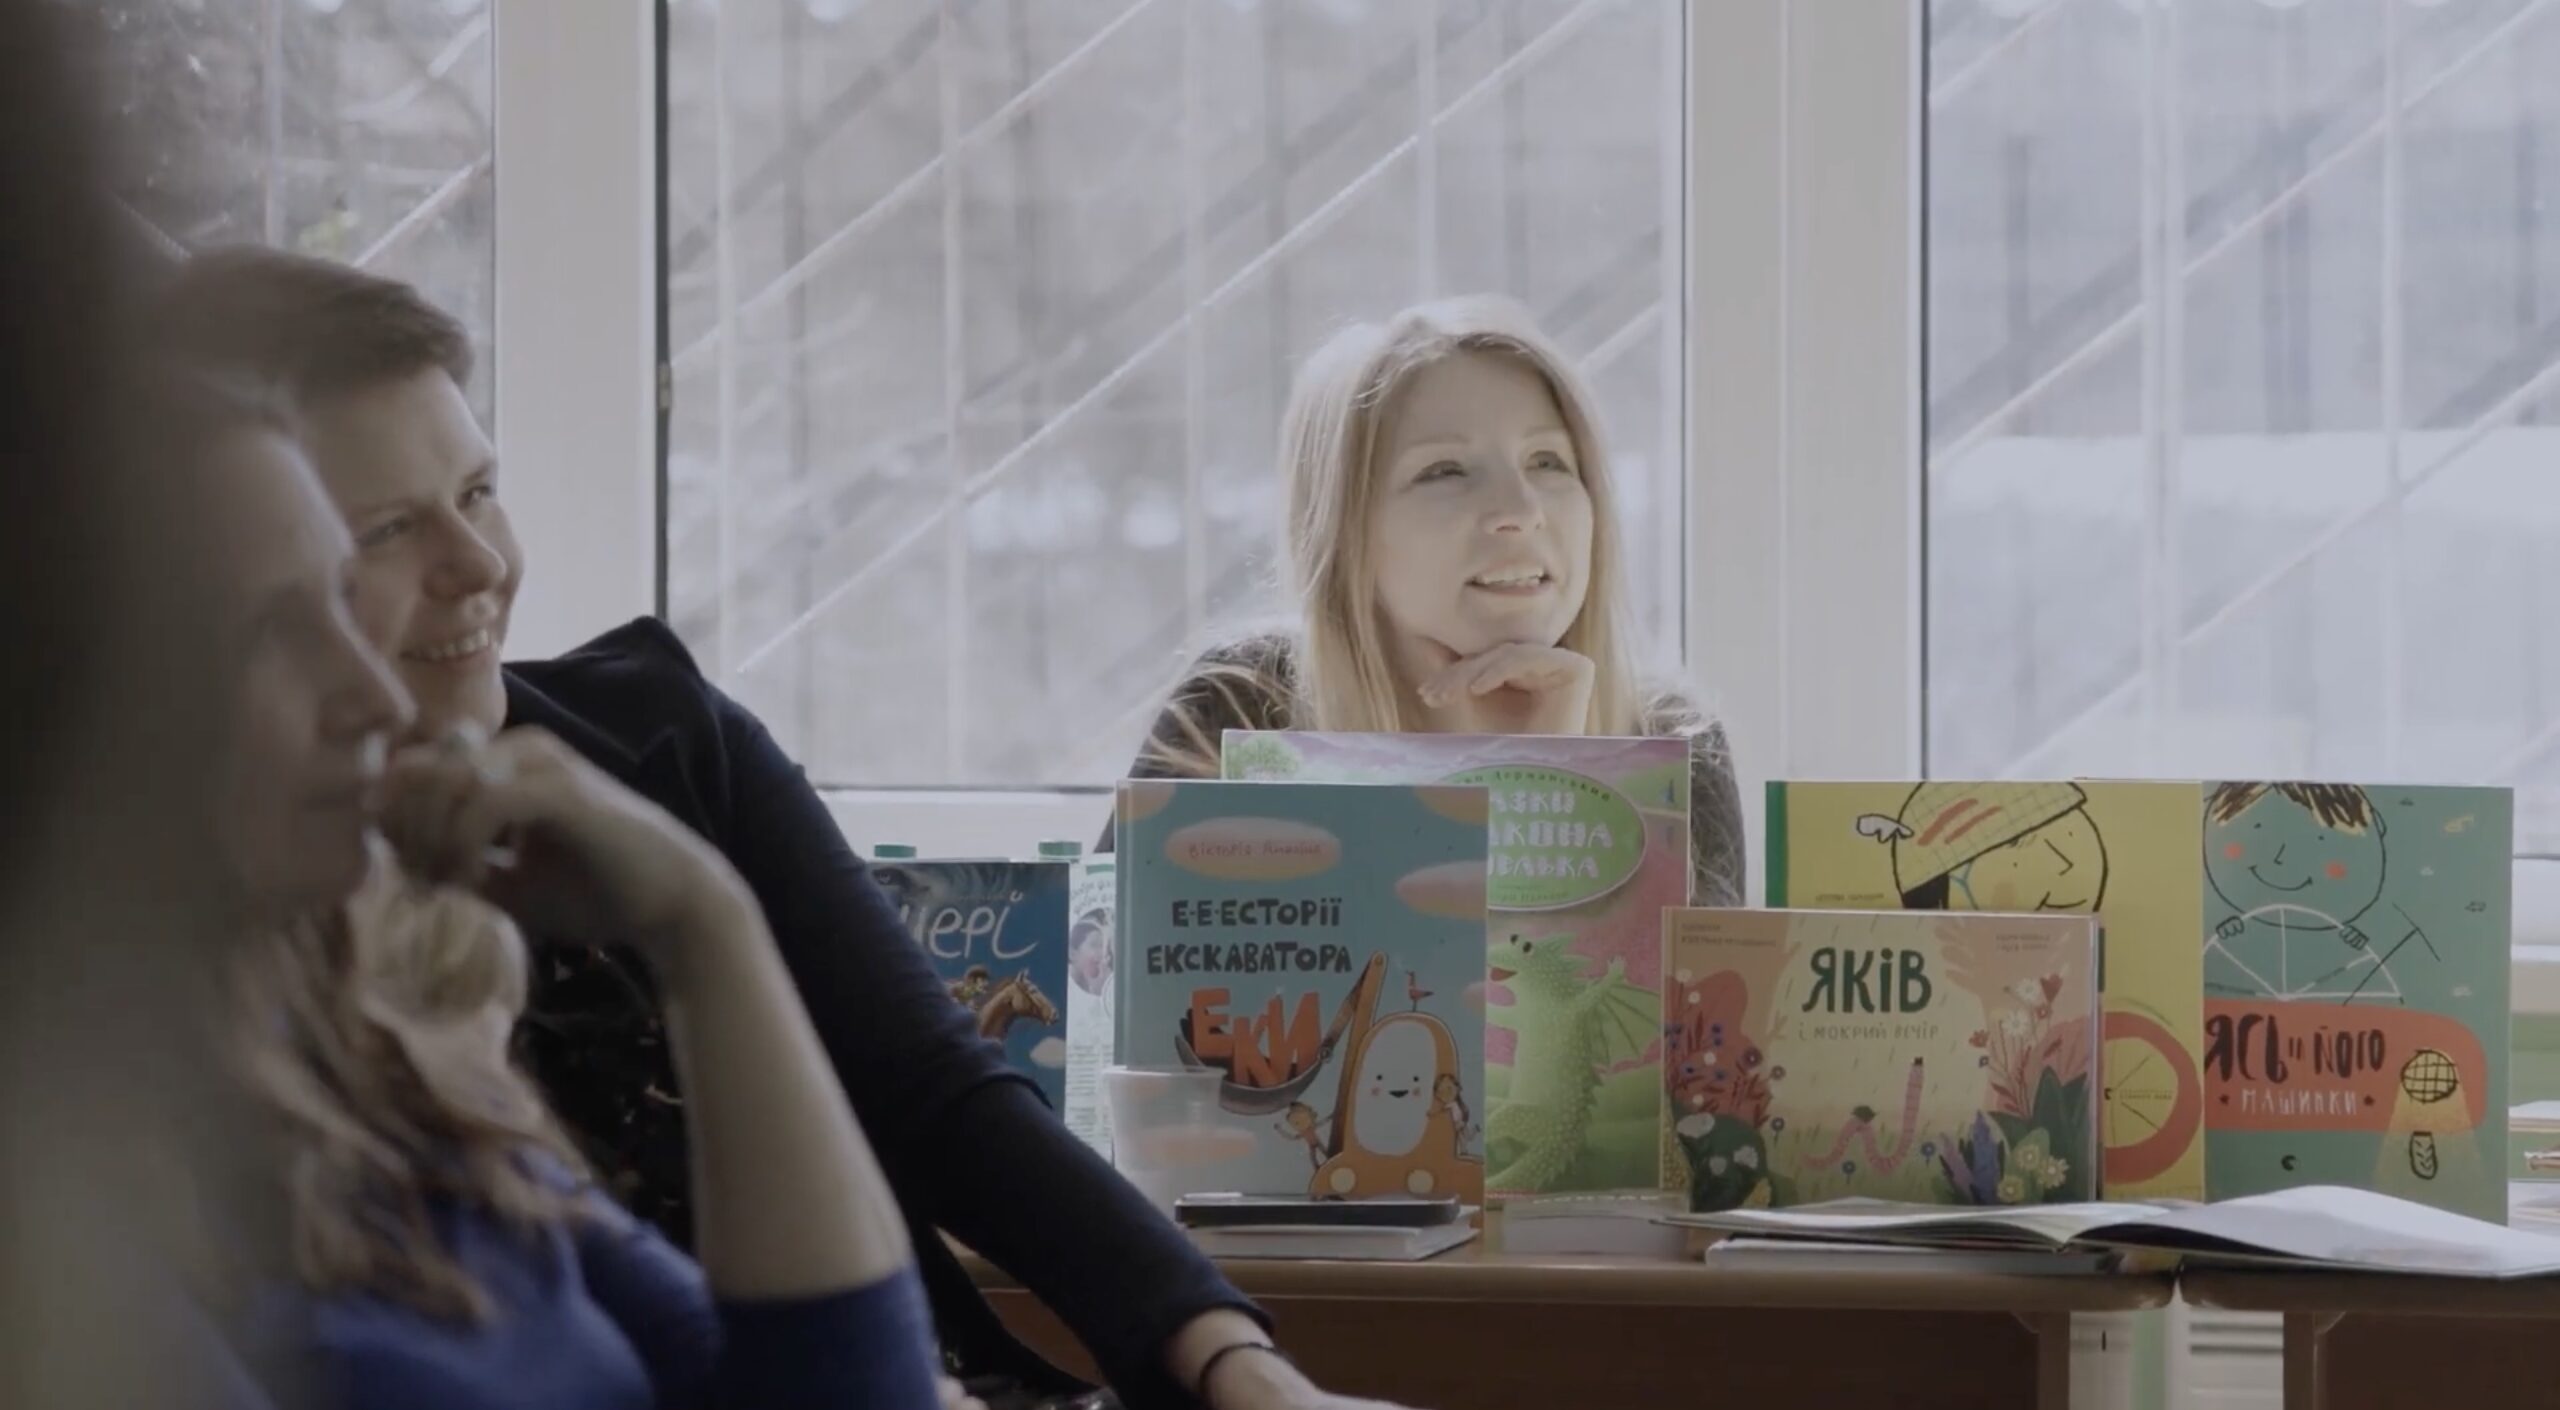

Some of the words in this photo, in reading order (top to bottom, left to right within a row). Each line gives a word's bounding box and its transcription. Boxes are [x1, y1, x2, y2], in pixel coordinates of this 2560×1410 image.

[1489, 789, 1576, 815] АЗКИ
[1489, 819, 1614, 849] КОНА
[1146, 941, 1352, 975] ЕКСКАВАТОРА
[2204, 1013, 2289, 1084] ЯСЬ
[2240, 1087, 2358, 1116] МАШИНКИ
